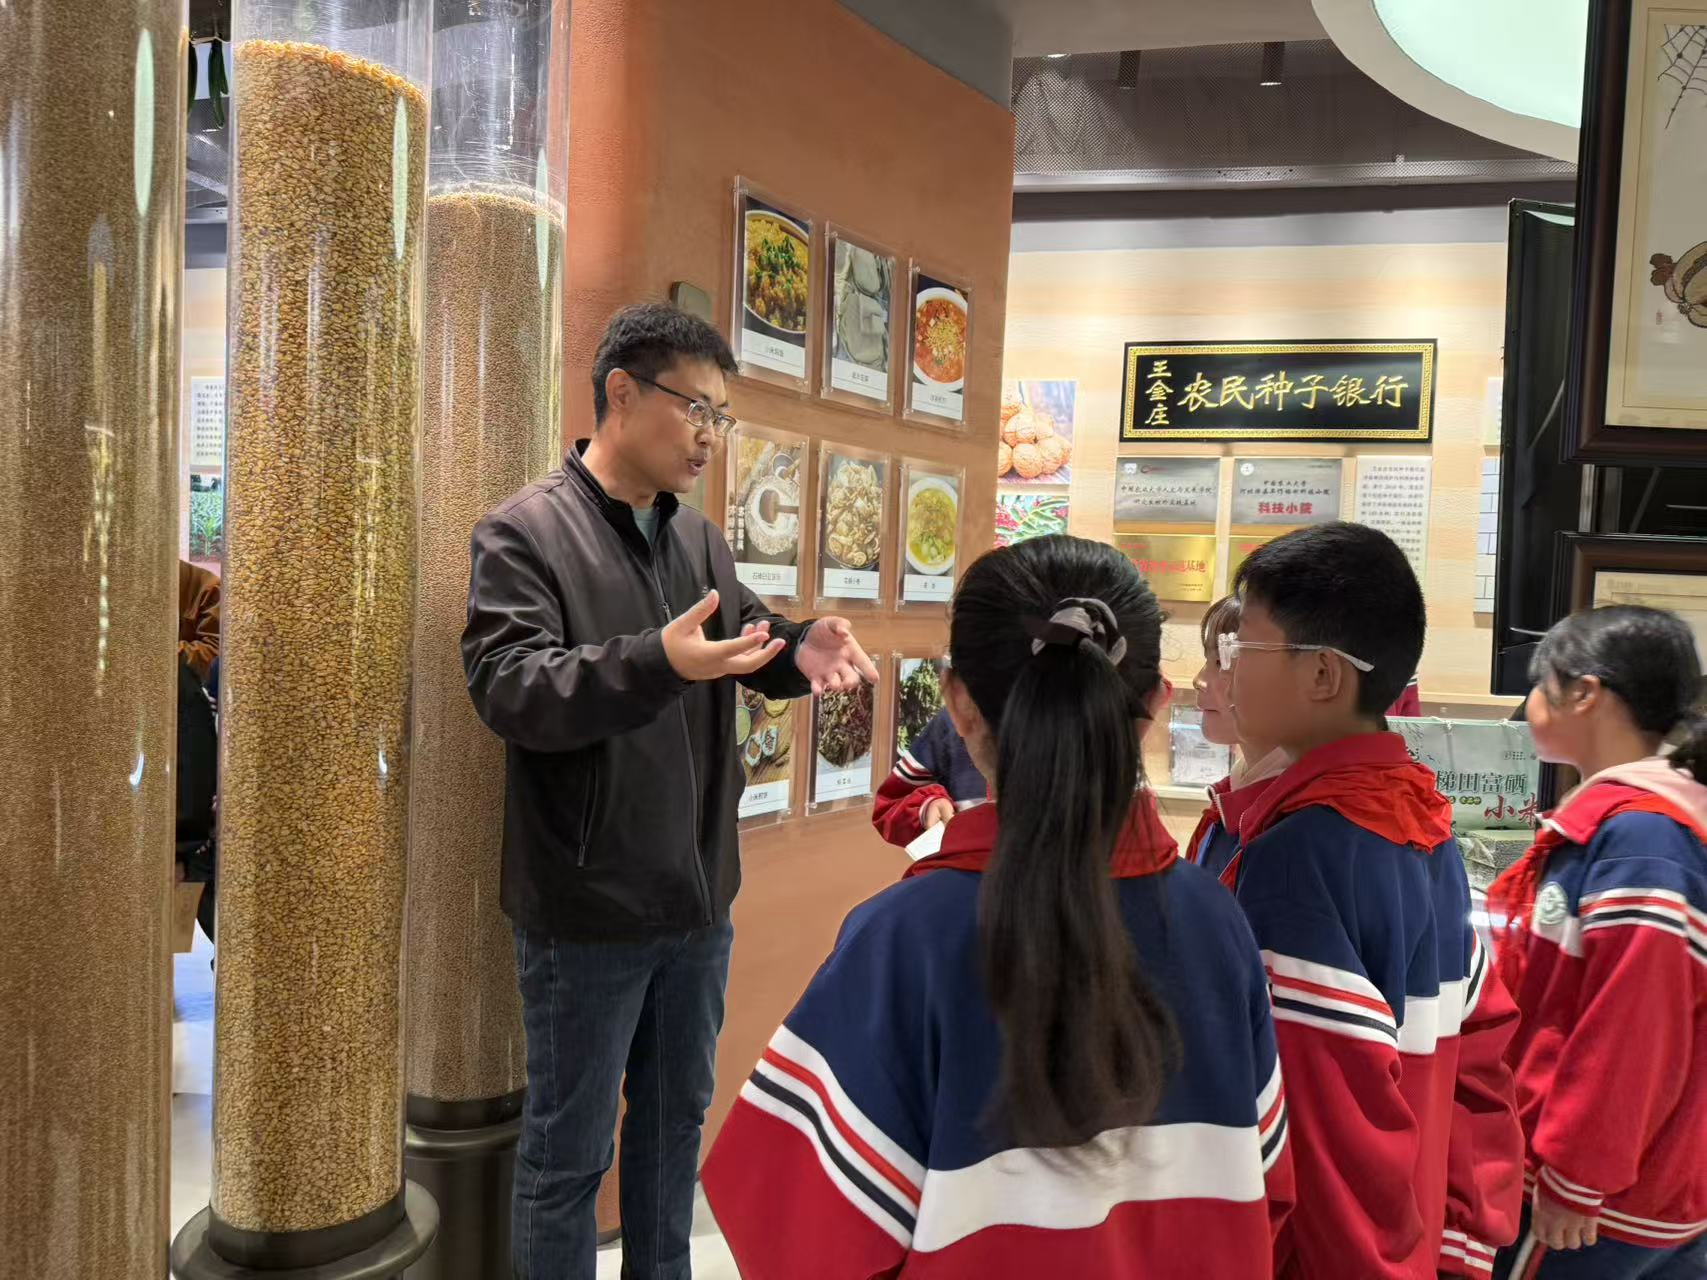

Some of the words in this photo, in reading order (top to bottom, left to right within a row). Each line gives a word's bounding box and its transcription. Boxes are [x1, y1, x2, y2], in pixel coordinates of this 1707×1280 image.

[1145, 360, 1174, 426] 王金庄
[1177, 370, 1409, 412] 农民种子银行
[1258, 502, 1313, 514] 科技小院
